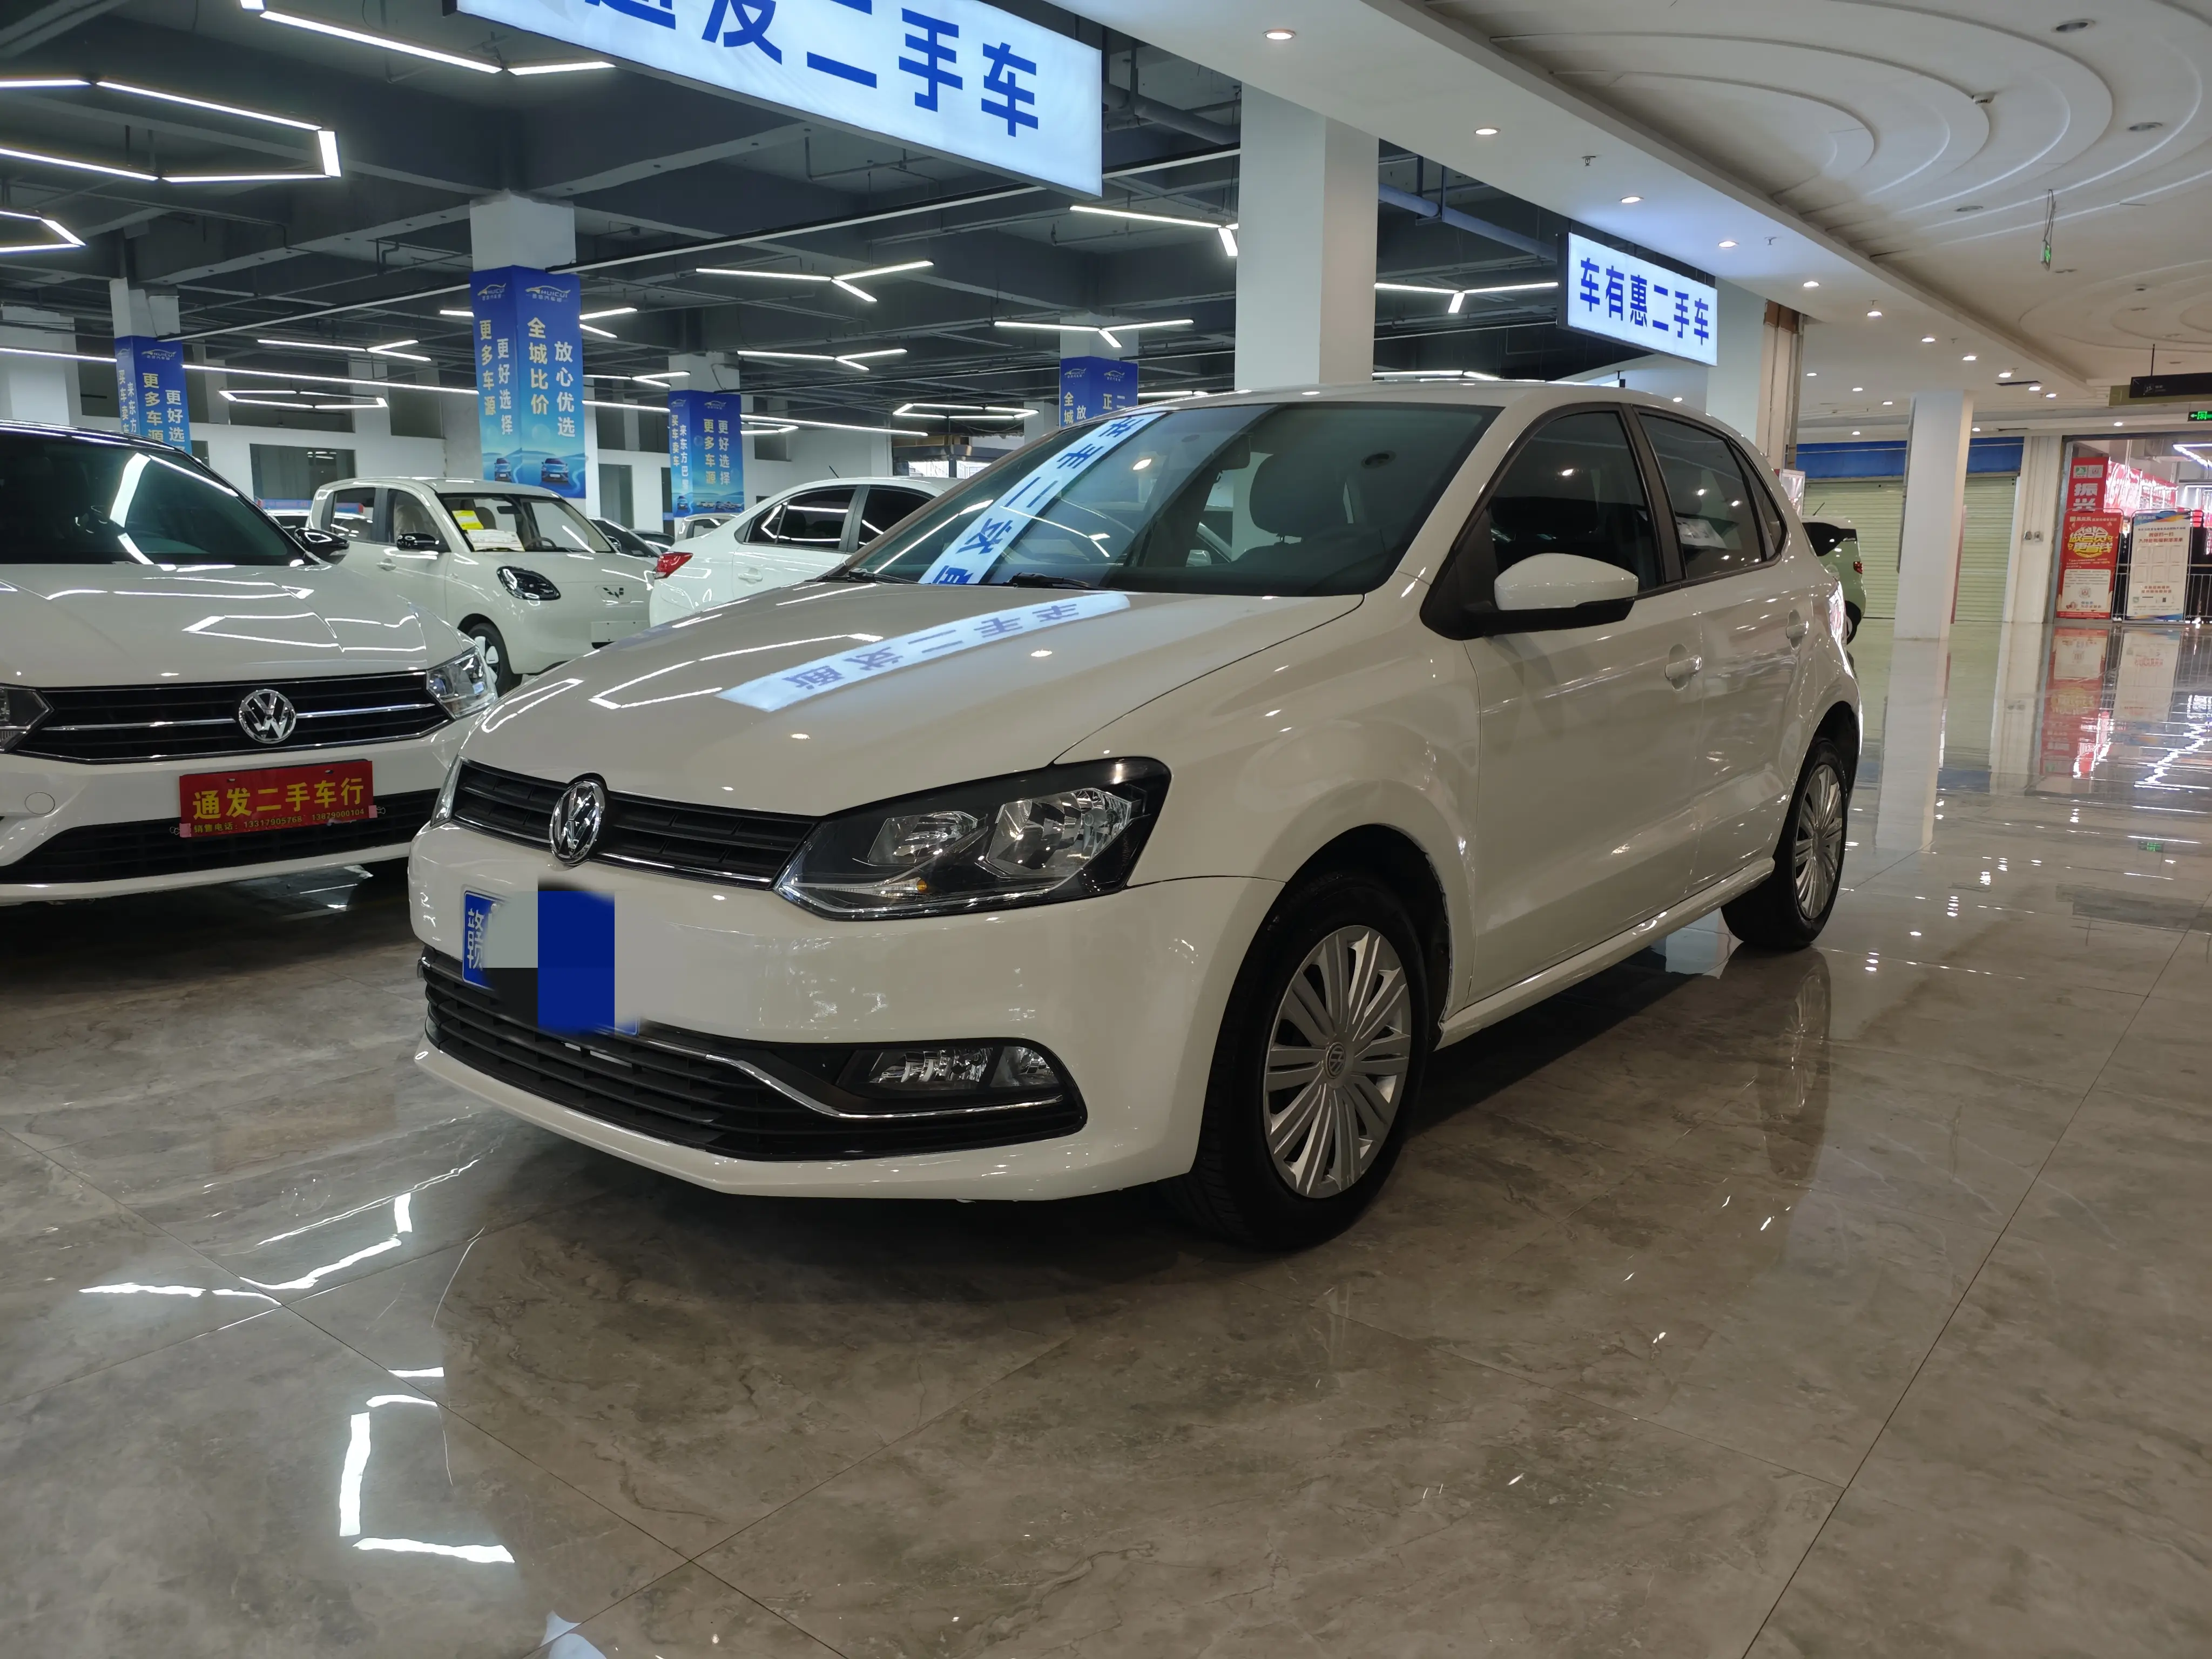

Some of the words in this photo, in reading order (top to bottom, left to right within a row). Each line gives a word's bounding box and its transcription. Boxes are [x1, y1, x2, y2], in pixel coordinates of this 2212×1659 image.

[585, 0, 1038, 137] 发二手车
[541, 290, 568, 298] HUICUI
[1580, 257, 1709, 346] 车有惠二手车
[480, 320, 496, 416] 更多车源
[497, 338, 513, 435] 更好选择
[528, 317, 549, 415] 全城比价
[555, 341, 575, 437] 放心优选
[1064, 392, 1074, 424] 全城
[1077, 405, 1087, 420] 放
[1103, 393, 1112, 410] 正
[704, 419, 716, 484] 更多车源
[718, 420, 730, 485] 更好选择
[192, 778, 364, 820] 通发二手车行
[244, 816, 302, 828] 13317905768
